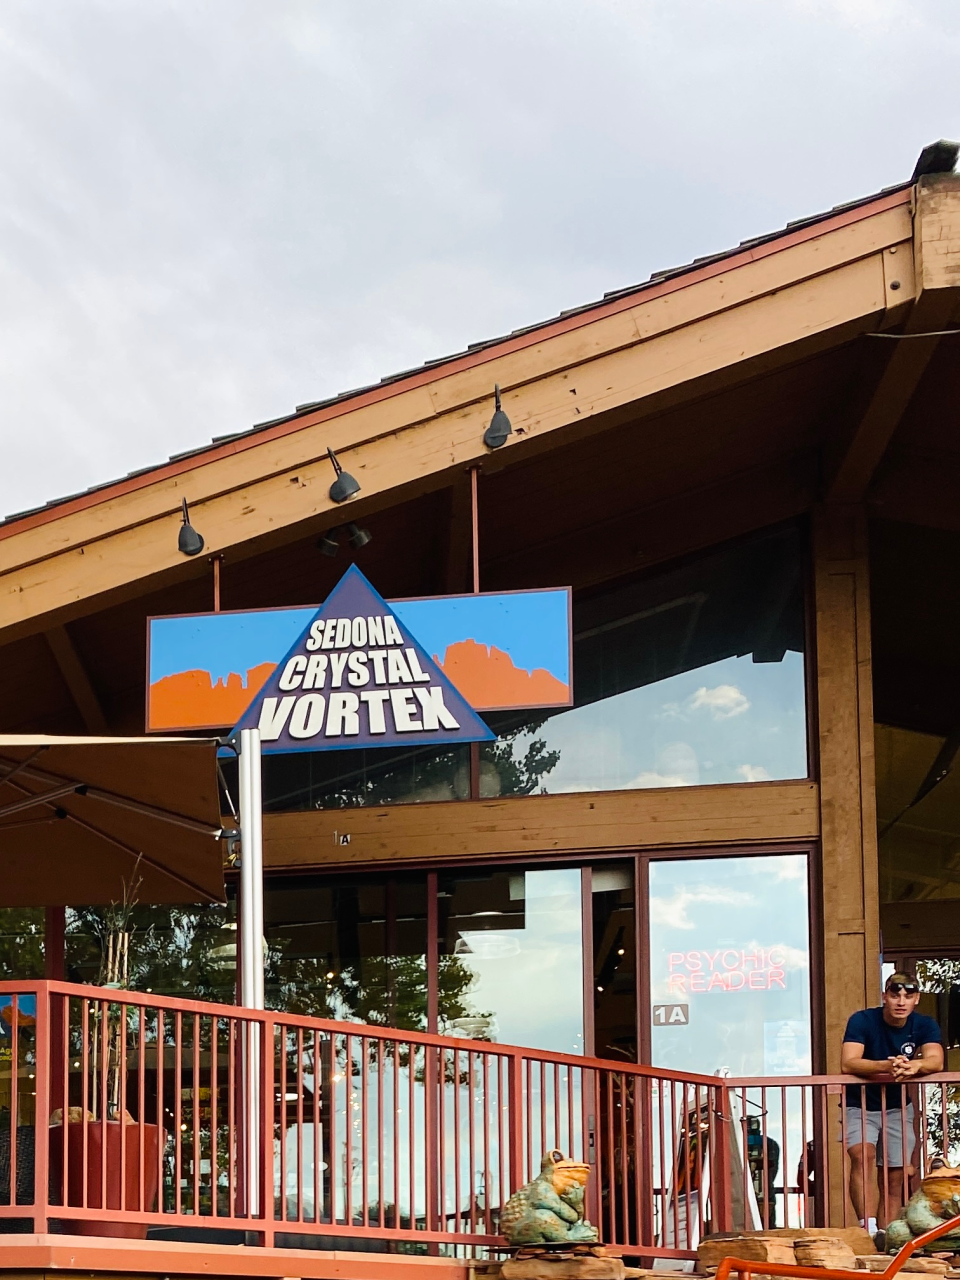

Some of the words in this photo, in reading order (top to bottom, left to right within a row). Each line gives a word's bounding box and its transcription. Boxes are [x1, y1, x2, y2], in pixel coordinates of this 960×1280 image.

[305, 615, 404, 651] SEDONA
[278, 648, 431, 691] CRYSTAL
[258, 686, 461, 741] VORTEX
[668, 948, 786, 972] PSYCHIC
[669, 970, 786, 993] READER
[654, 1006, 687, 1024] 1A
